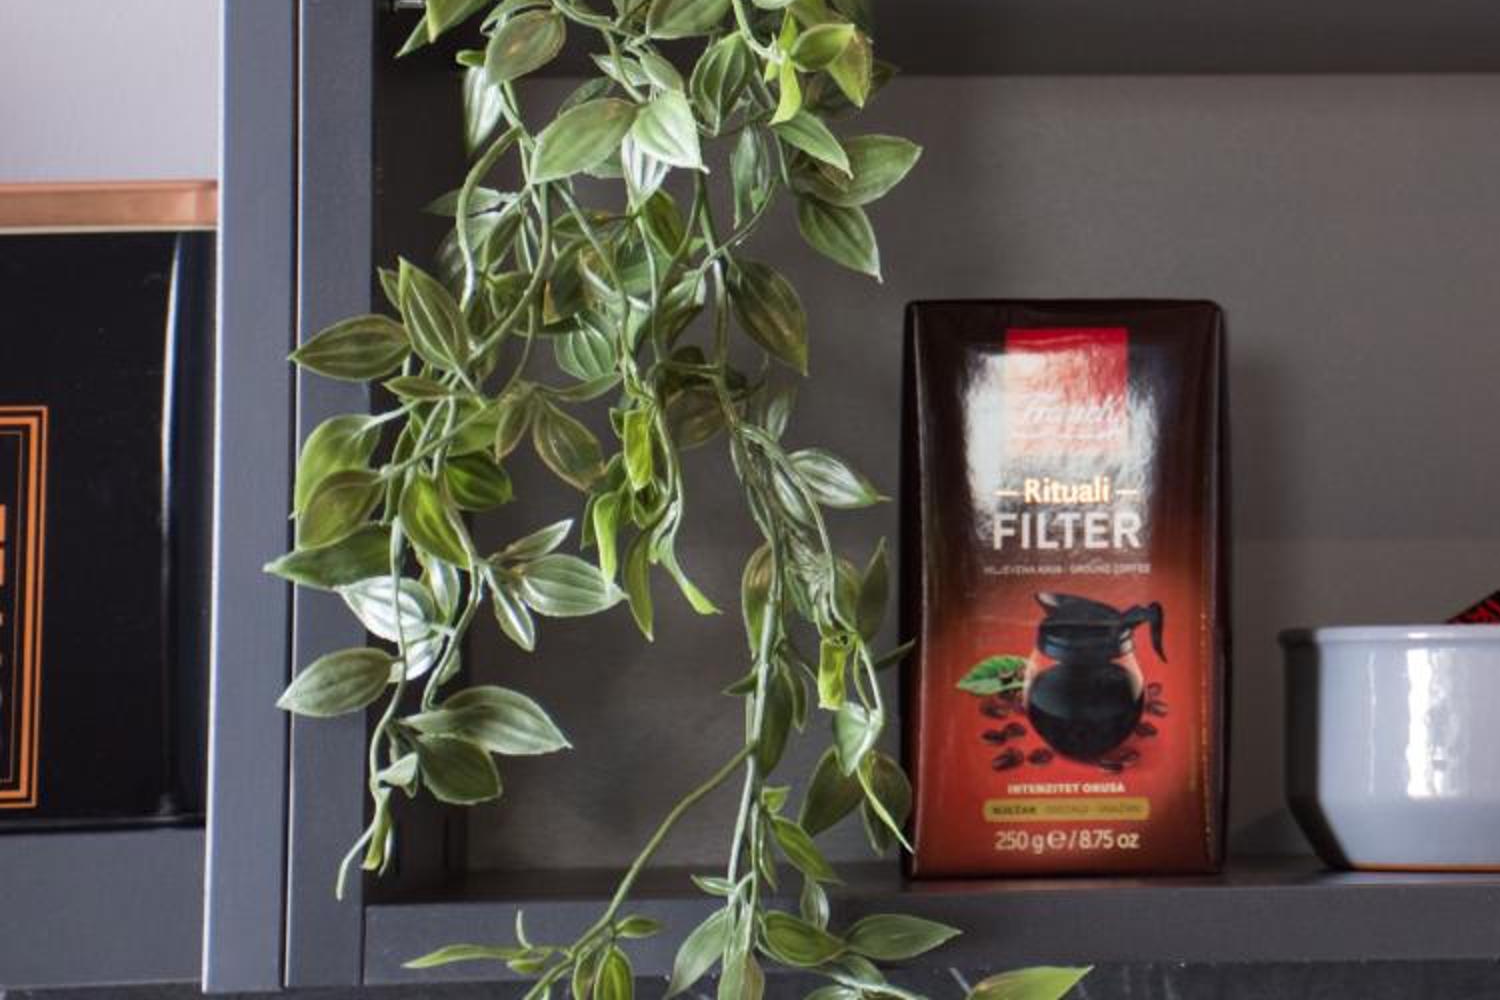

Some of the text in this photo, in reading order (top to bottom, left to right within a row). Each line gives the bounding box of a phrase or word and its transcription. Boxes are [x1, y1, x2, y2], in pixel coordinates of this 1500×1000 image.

[1024, 476, 1110, 503] Rituali
[993, 511, 1142, 550] FILTER
[995, 830, 1029, 851] 250
[1116, 832, 1139, 849] oz
